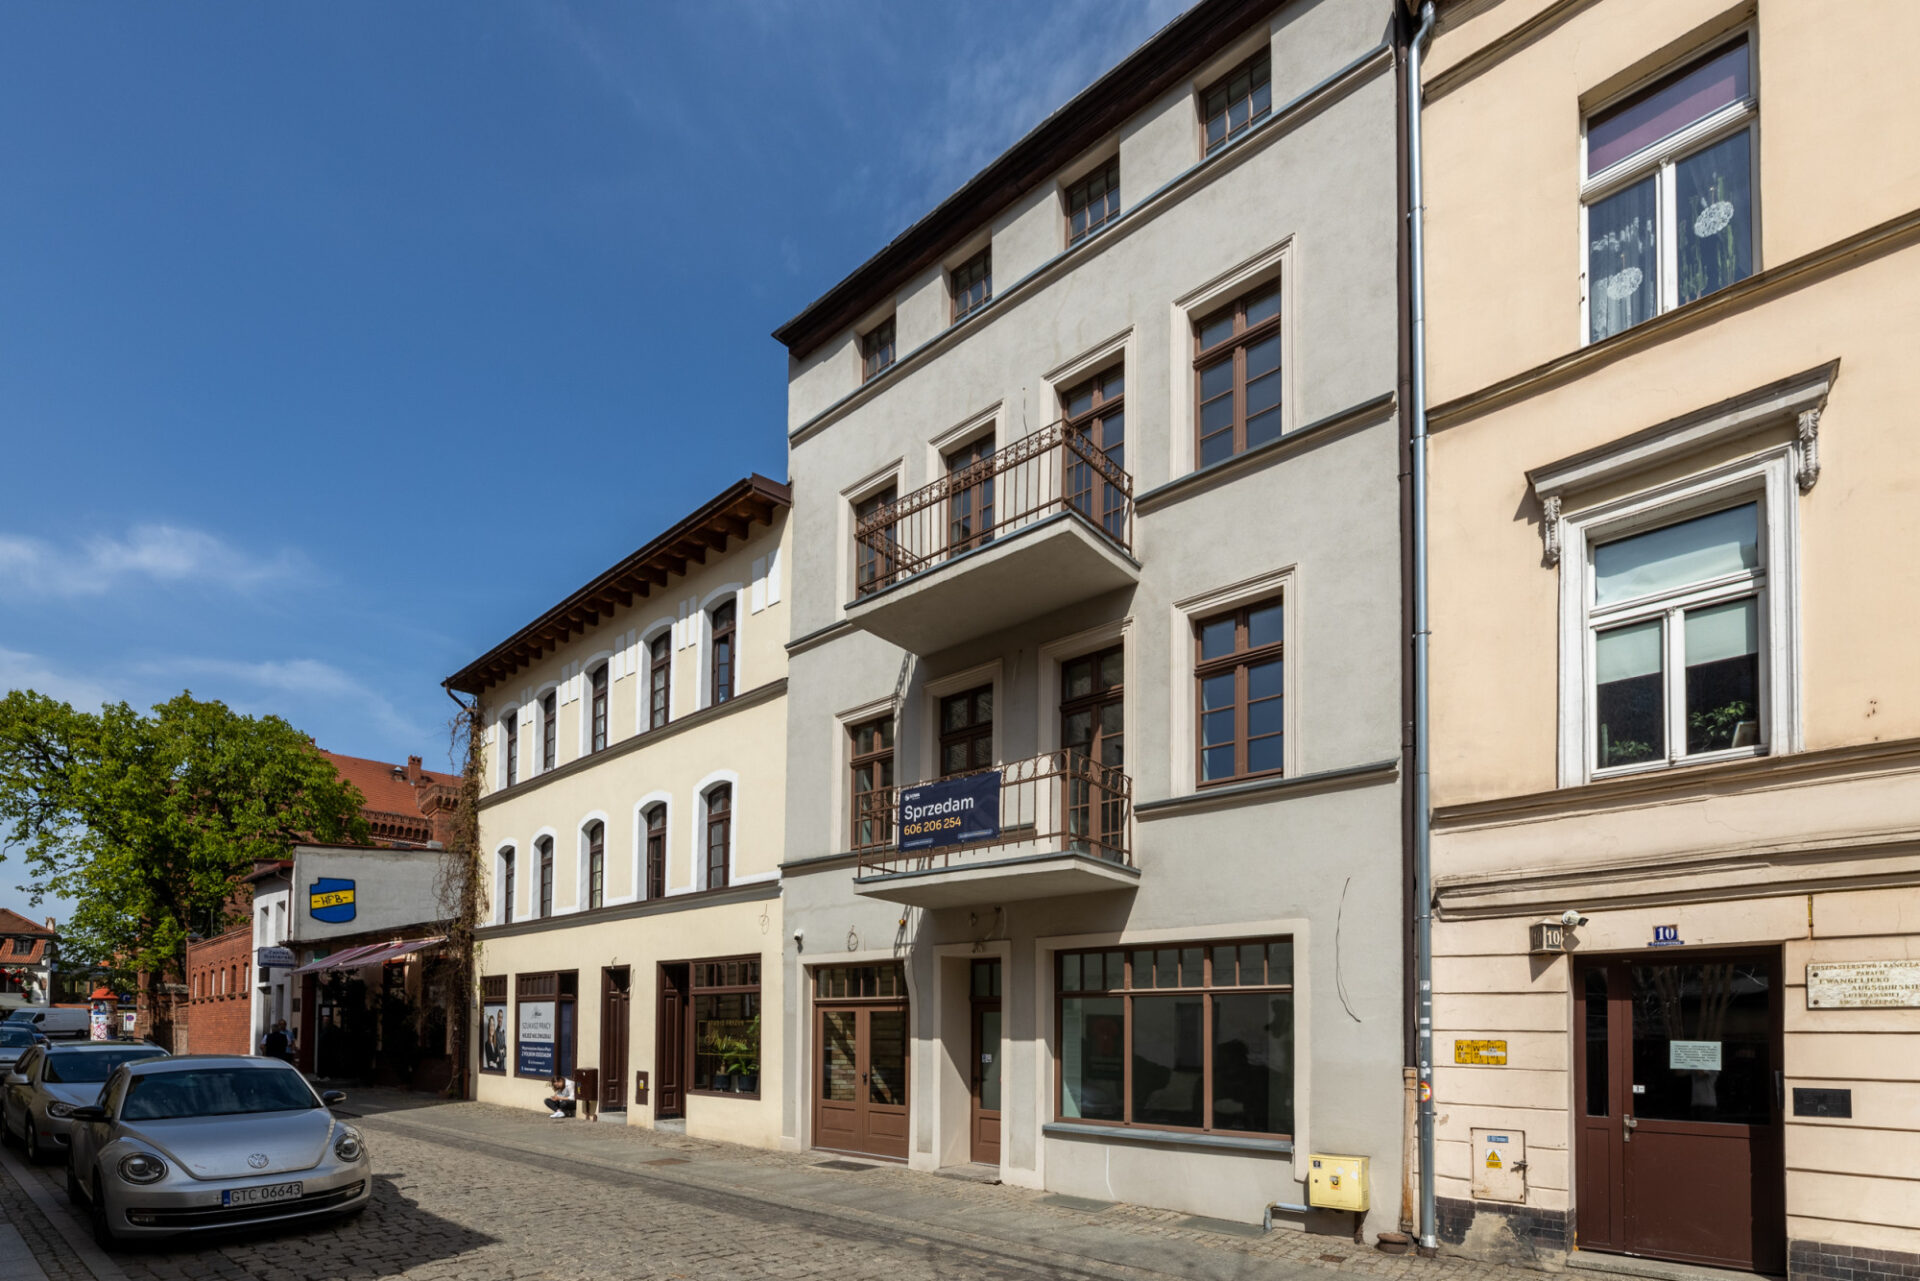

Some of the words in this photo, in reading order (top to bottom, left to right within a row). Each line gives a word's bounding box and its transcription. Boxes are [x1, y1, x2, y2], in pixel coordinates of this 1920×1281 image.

[904, 797, 974, 822] Sprzedam
[904, 823, 922, 835] 606
[923, 819, 942, 832] 206
[943, 816, 962, 829] 254
[1547, 930, 1560, 944] 10
[1658, 927, 1675, 940] 10
[231, 1189, 257, 1203] GTC
[261, 1184, 301, 1200] 06643
